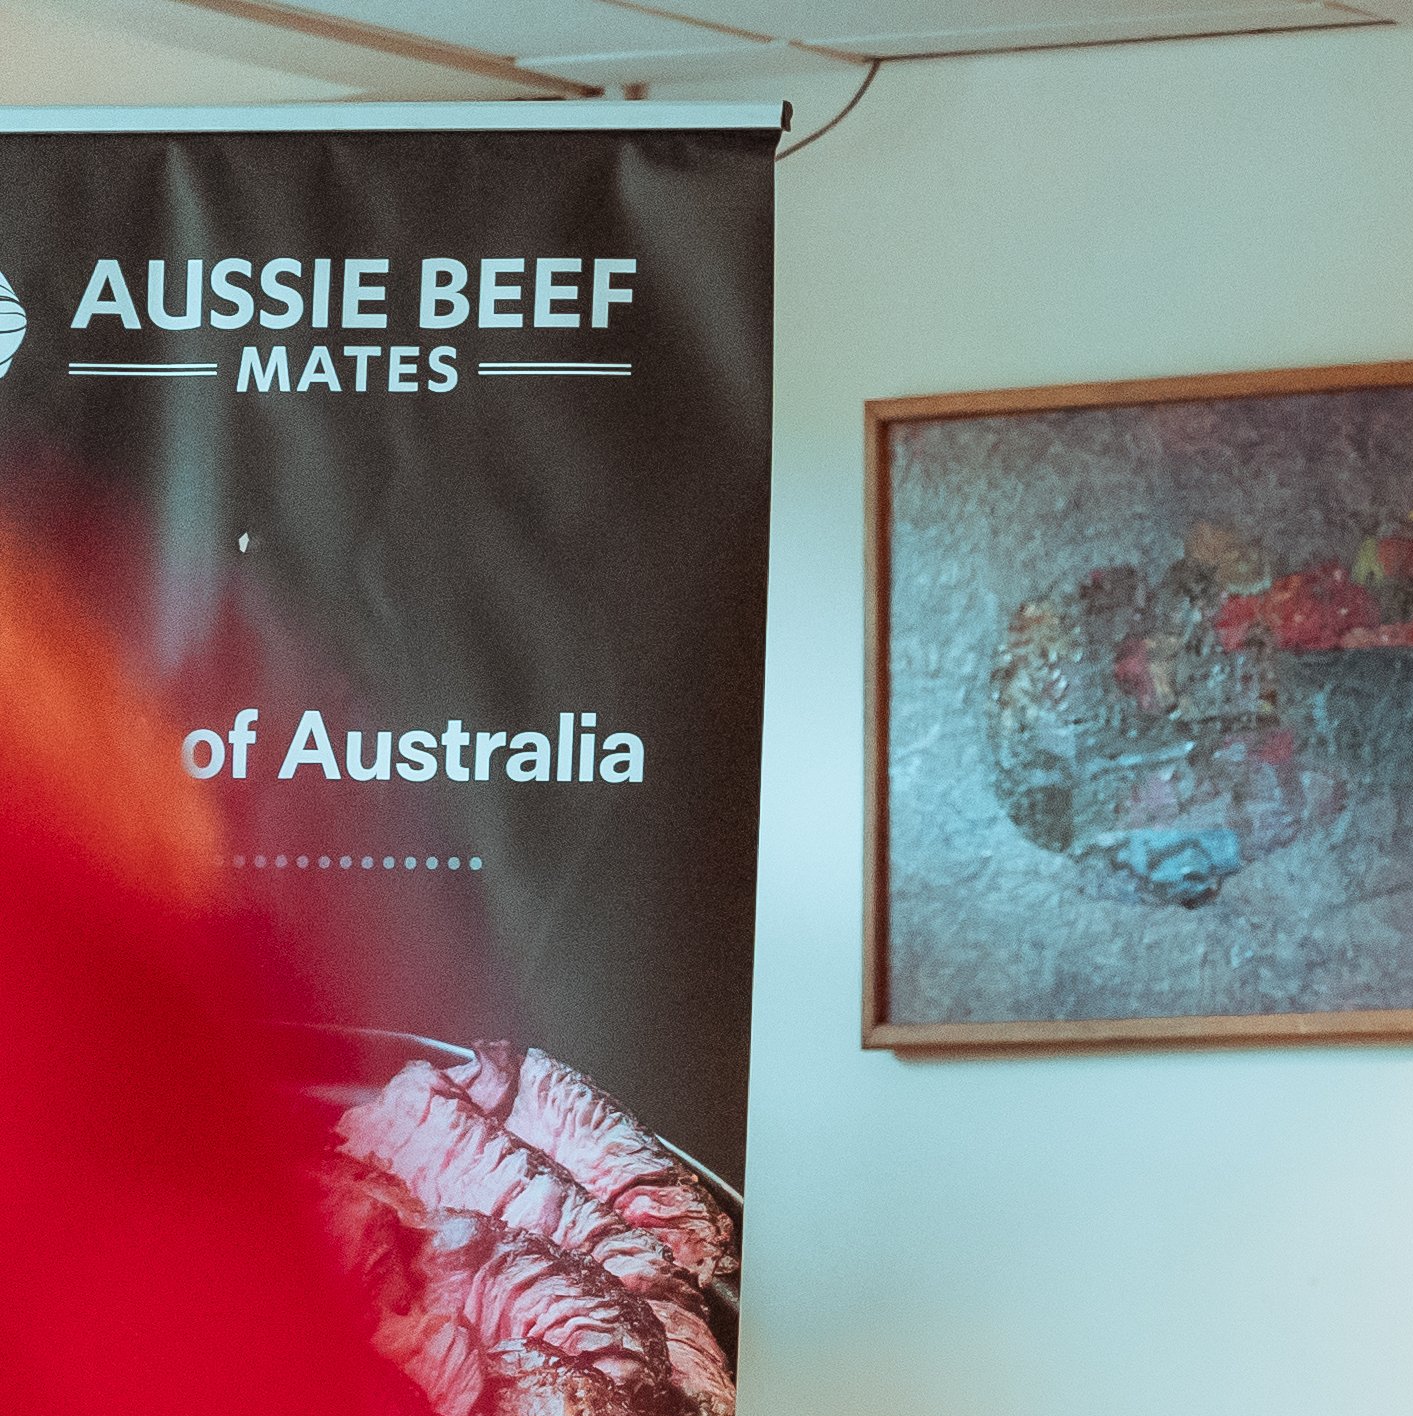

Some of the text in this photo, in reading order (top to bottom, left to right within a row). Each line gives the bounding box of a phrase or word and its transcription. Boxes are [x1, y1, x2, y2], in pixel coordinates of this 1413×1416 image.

[70, 257, 638, 331] AUSSIE BEEF
[236, 345, 460, 393] MATES
[181, 708, 646, 784] of Australia
